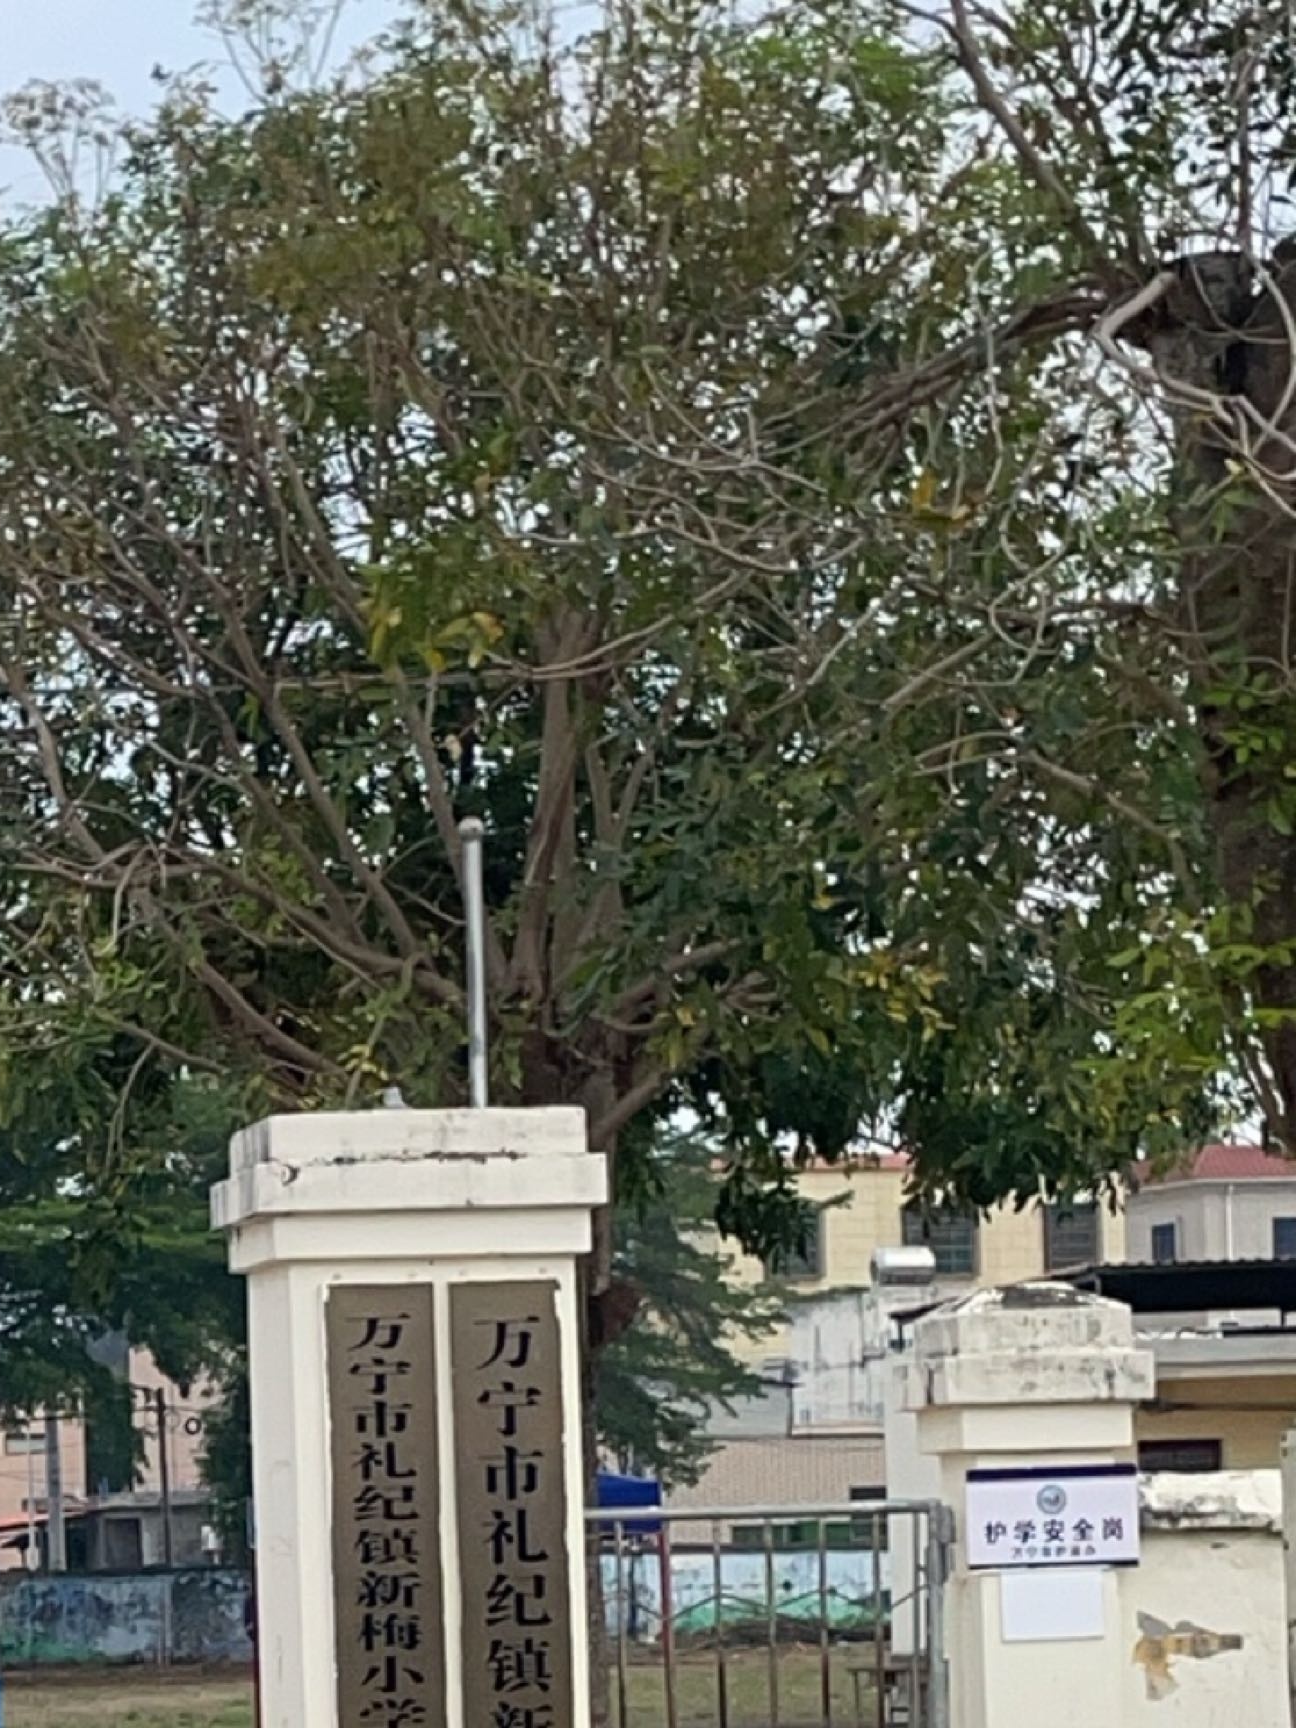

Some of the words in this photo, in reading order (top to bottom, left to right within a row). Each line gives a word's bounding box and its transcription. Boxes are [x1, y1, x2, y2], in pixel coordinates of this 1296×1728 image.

[984, 1517, 1124, 1544] 护学安全岗
